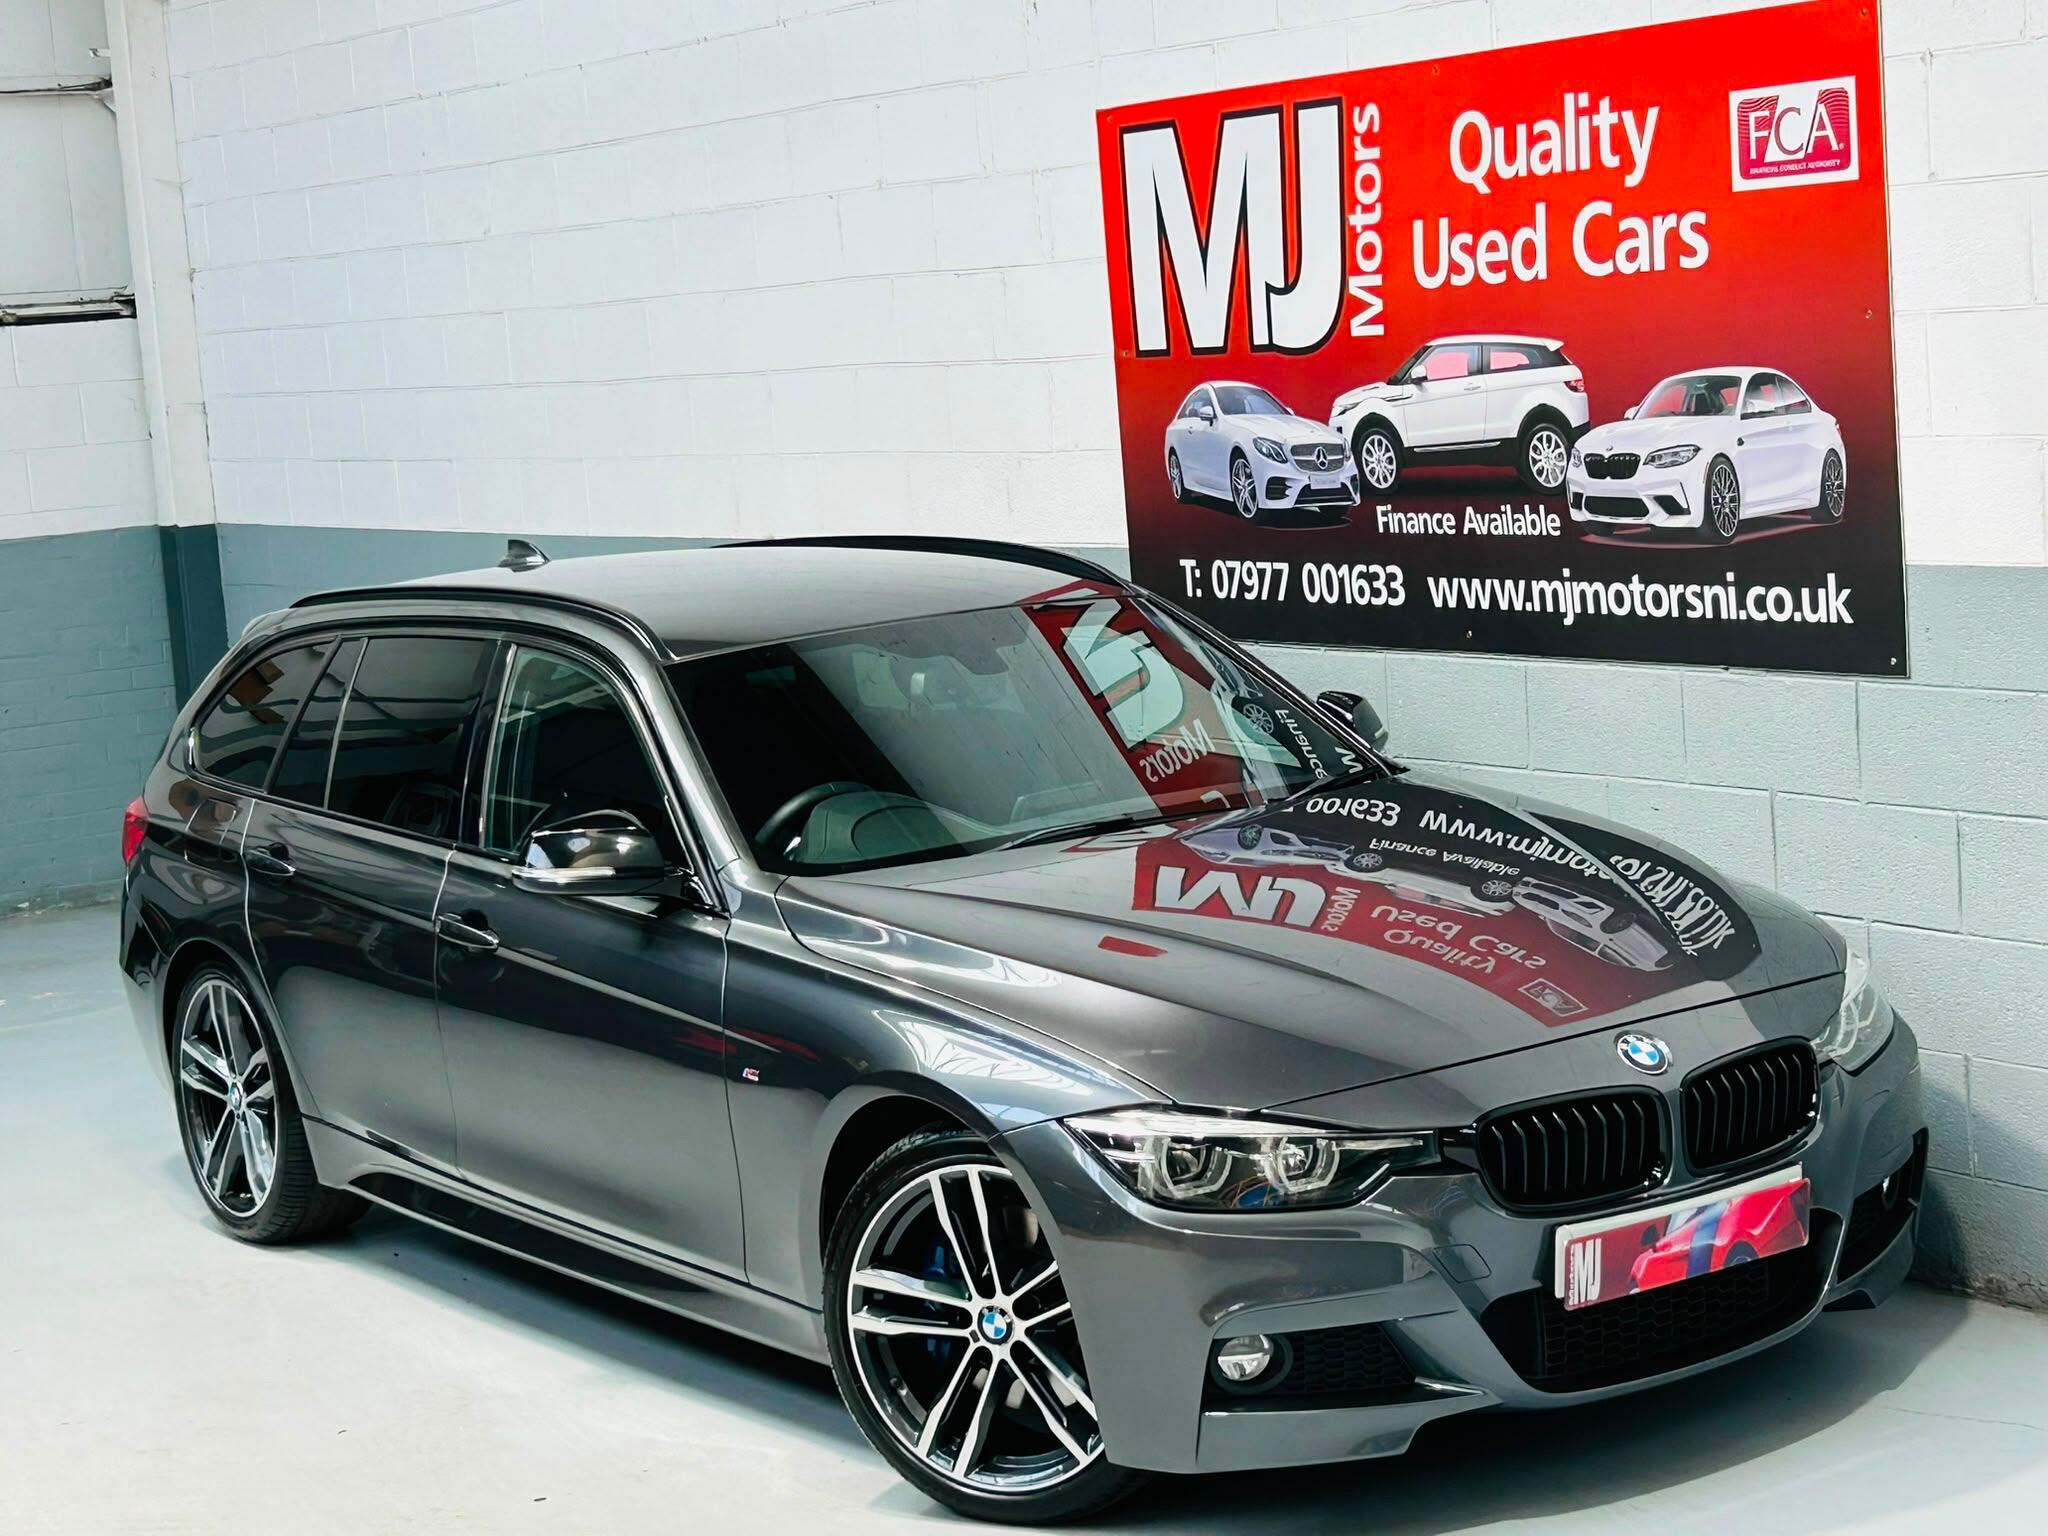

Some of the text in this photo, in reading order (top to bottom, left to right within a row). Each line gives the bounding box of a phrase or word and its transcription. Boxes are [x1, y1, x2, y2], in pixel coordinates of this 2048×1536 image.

[1449, 91, 1660, 195] Quality
[1748, 103, 1840, 160] FCA
[1120, 97, 1343, 357] MJ
[1347, 102, 1385, 337] Motors
[1413, 200, 1710, 290] Used Cars
[1375, 503, 1561, 537] Finance Available
[1179, 558, 1406, 607] T: 07977 001633
[1426, 567, 1855, 626] www.mjmotorsni.co.uk
